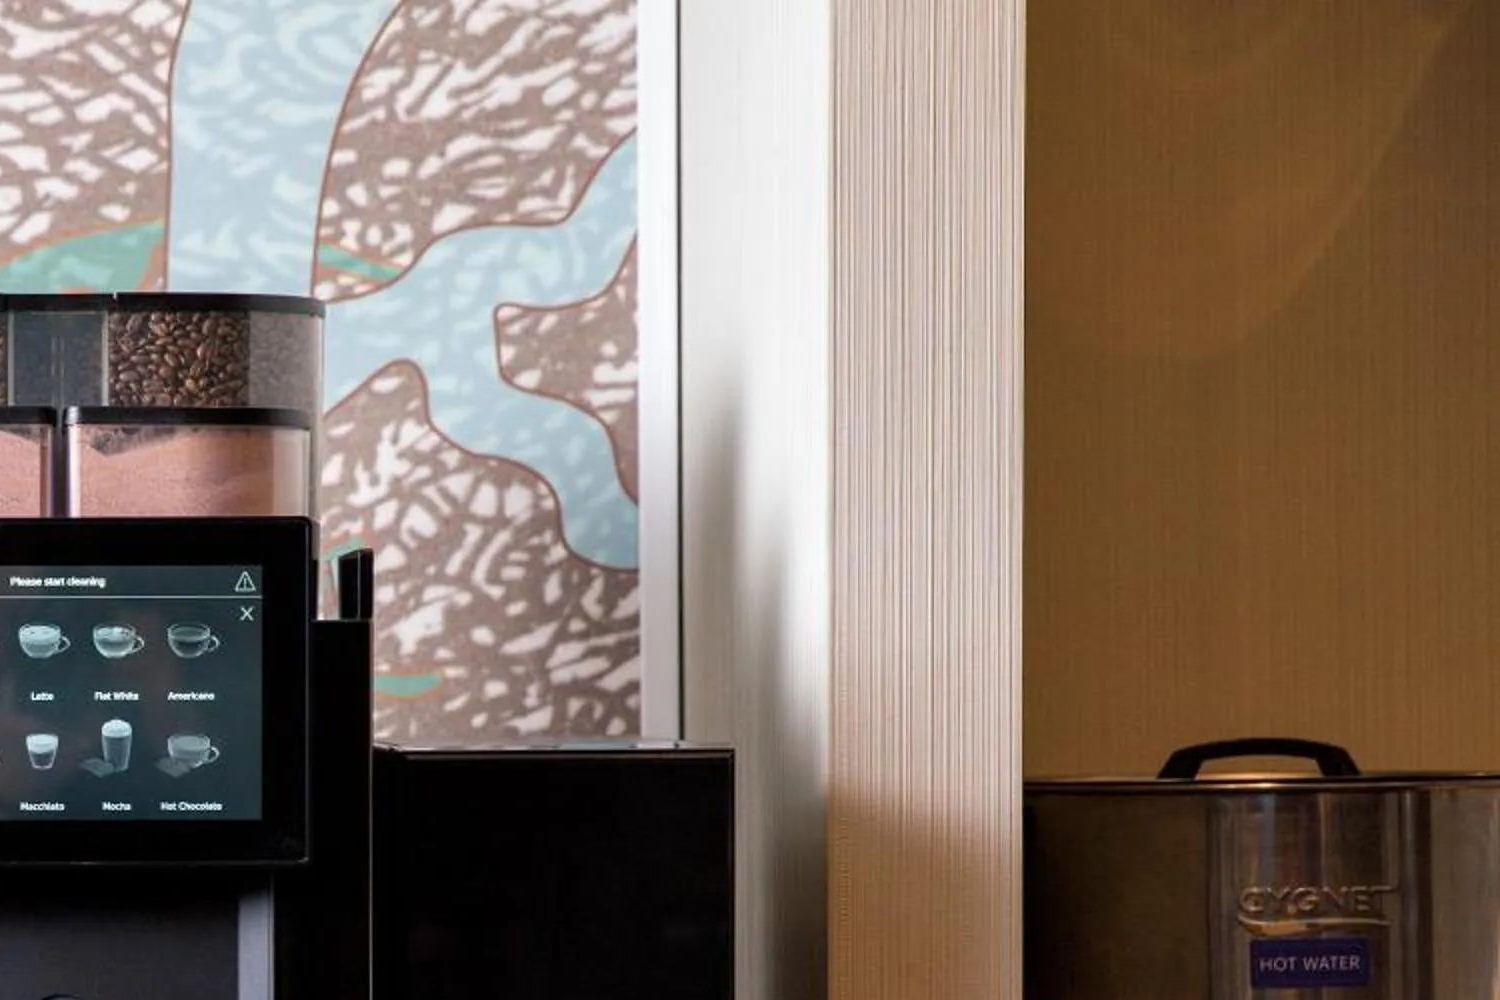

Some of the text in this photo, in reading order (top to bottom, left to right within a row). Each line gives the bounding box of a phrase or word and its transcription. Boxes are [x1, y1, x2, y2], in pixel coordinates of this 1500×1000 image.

[9, 575, 107, 590] Please start cleaning
[30, 691, 55, 702] Latte
[94, 691, 140, 702] Flat White
[167, 691, 216, 702] Americano
[19, 801, 65, 812] Macchiato
[102, 801, 132, 812] Mocha
[160, 801, 223, 812] Hot Chocolate
[1259, 955, 1361, 973] HOT WATER
